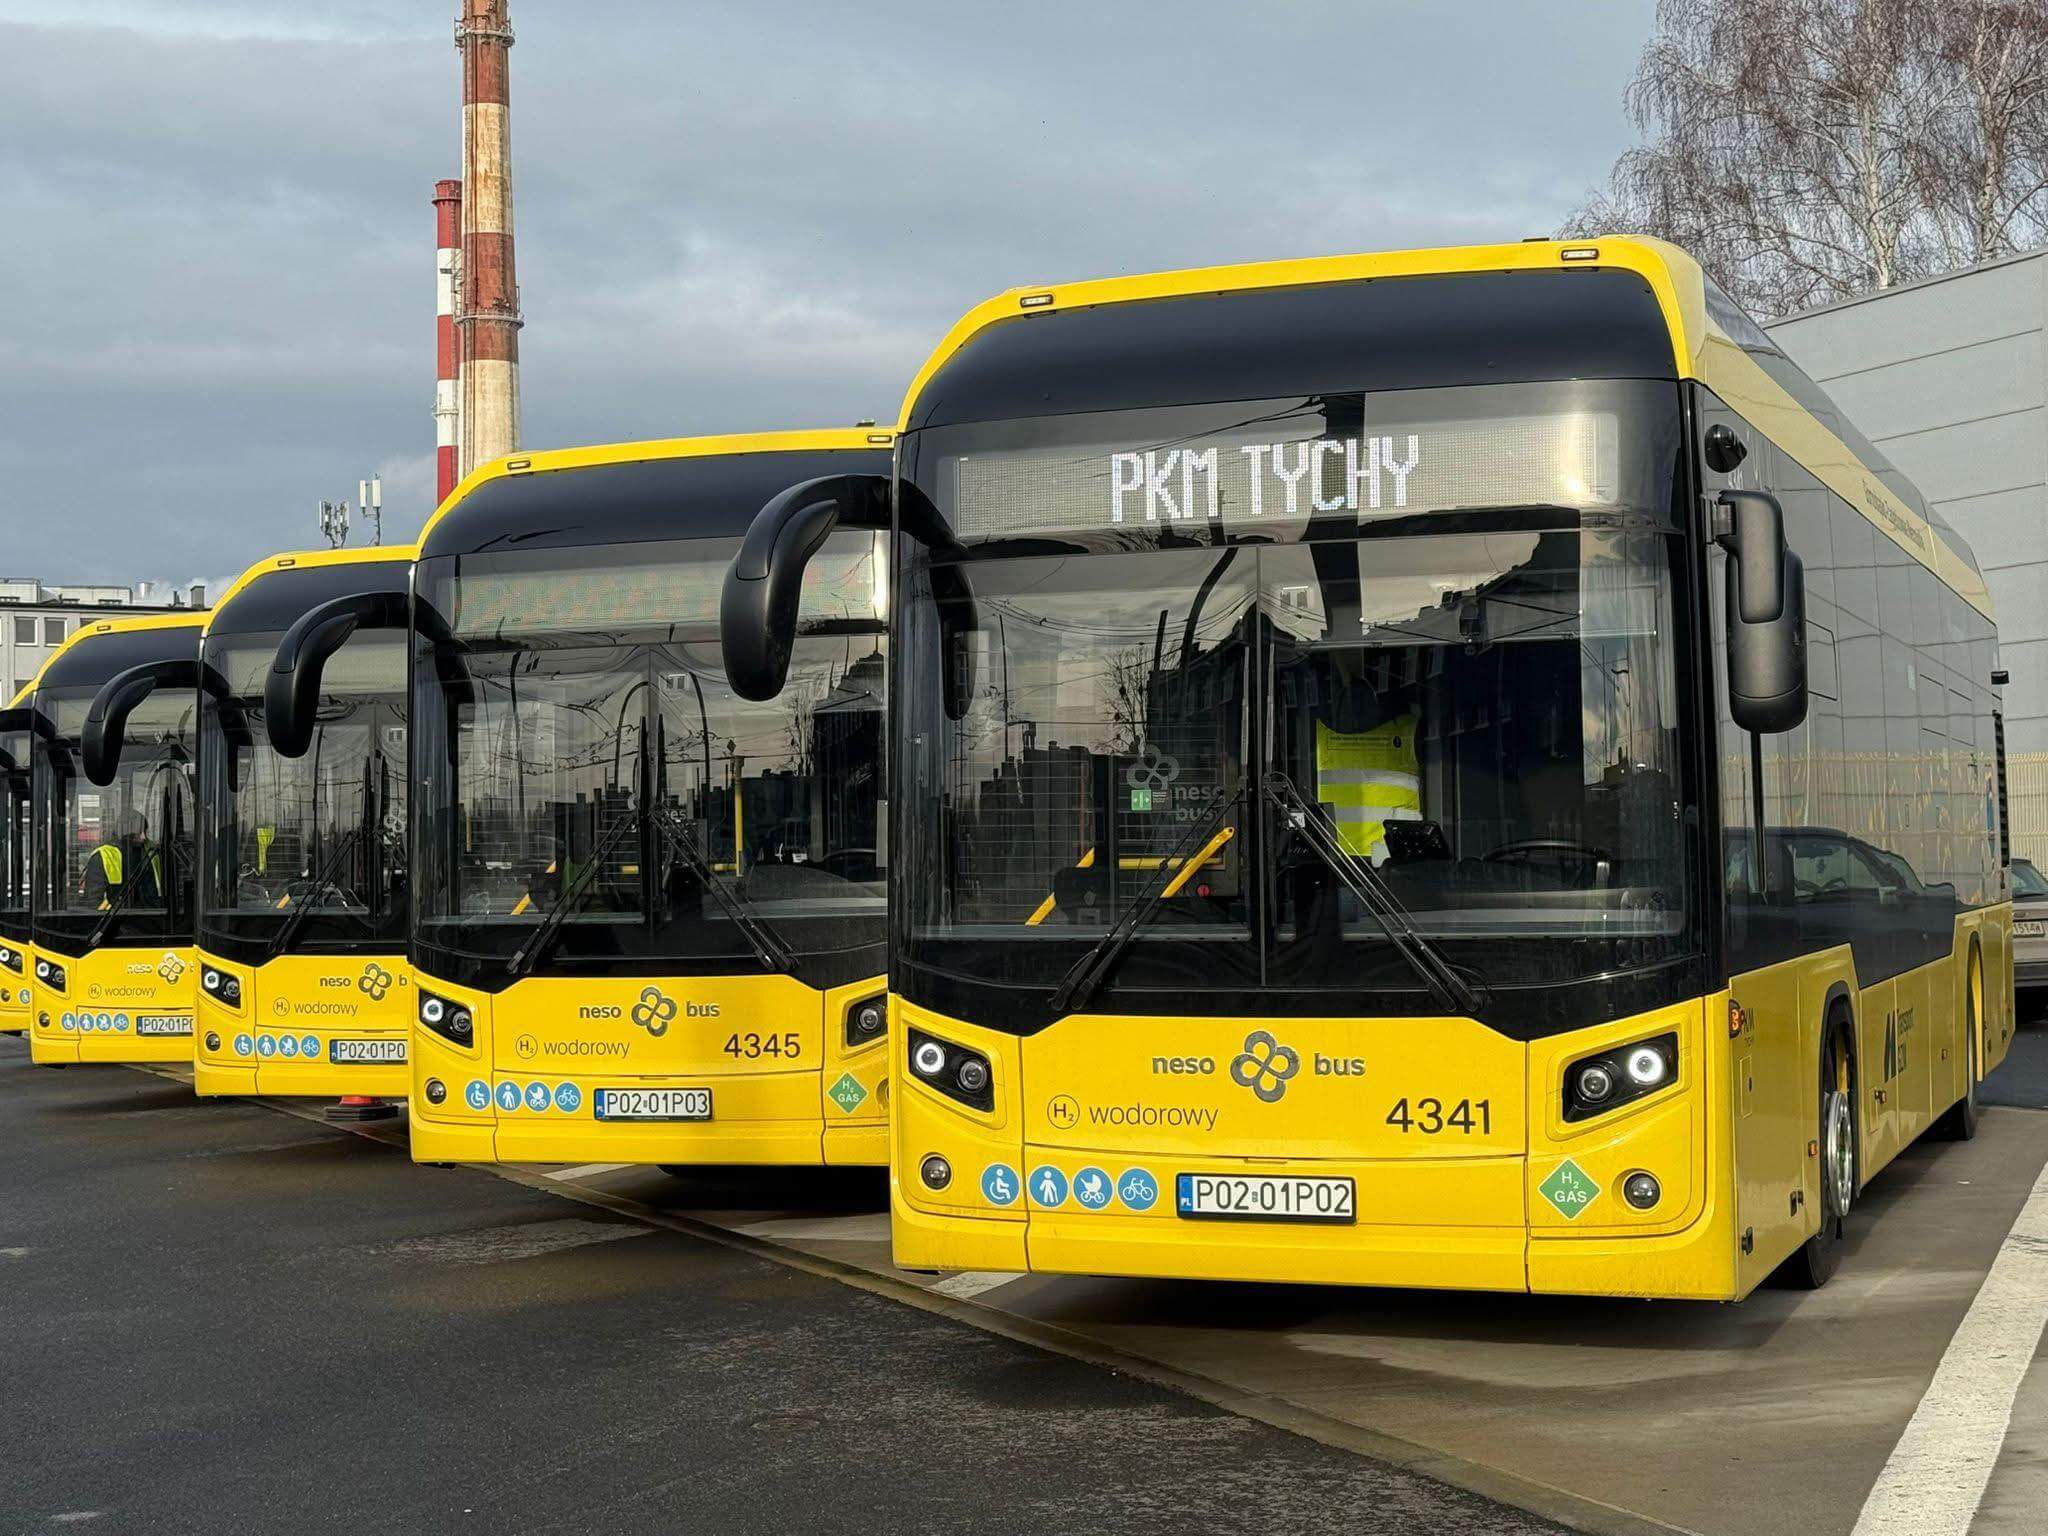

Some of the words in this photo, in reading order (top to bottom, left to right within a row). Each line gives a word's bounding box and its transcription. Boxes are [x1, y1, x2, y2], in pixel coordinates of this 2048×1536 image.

[1112, 448, 1218, 522] PKM
[1242, 434, 1419, 515] TYCHY
[320, 977, 351, 987] neso
[105, 986, 156, 998] wodorowy
[294, 1002, 358, 1016] wodorowy
[579, 1005, 622, 1018] neso
[686, 1000, 720, 1017] bus
[544, 1040, 630, 1058] wodorowy
[724, 1033, 800, 1058] 4345
[1152, 1056, 1215, 1075] neso
[1314, 1053, 1366, 1076] bus
[838, 1094, 859, 1103] GAS
[1089, 1102, 1218, 1131] wodorowy
[1386, 1098, 1491, 1135] 4341
[1554, 1191, 1587, 1203] GAS
